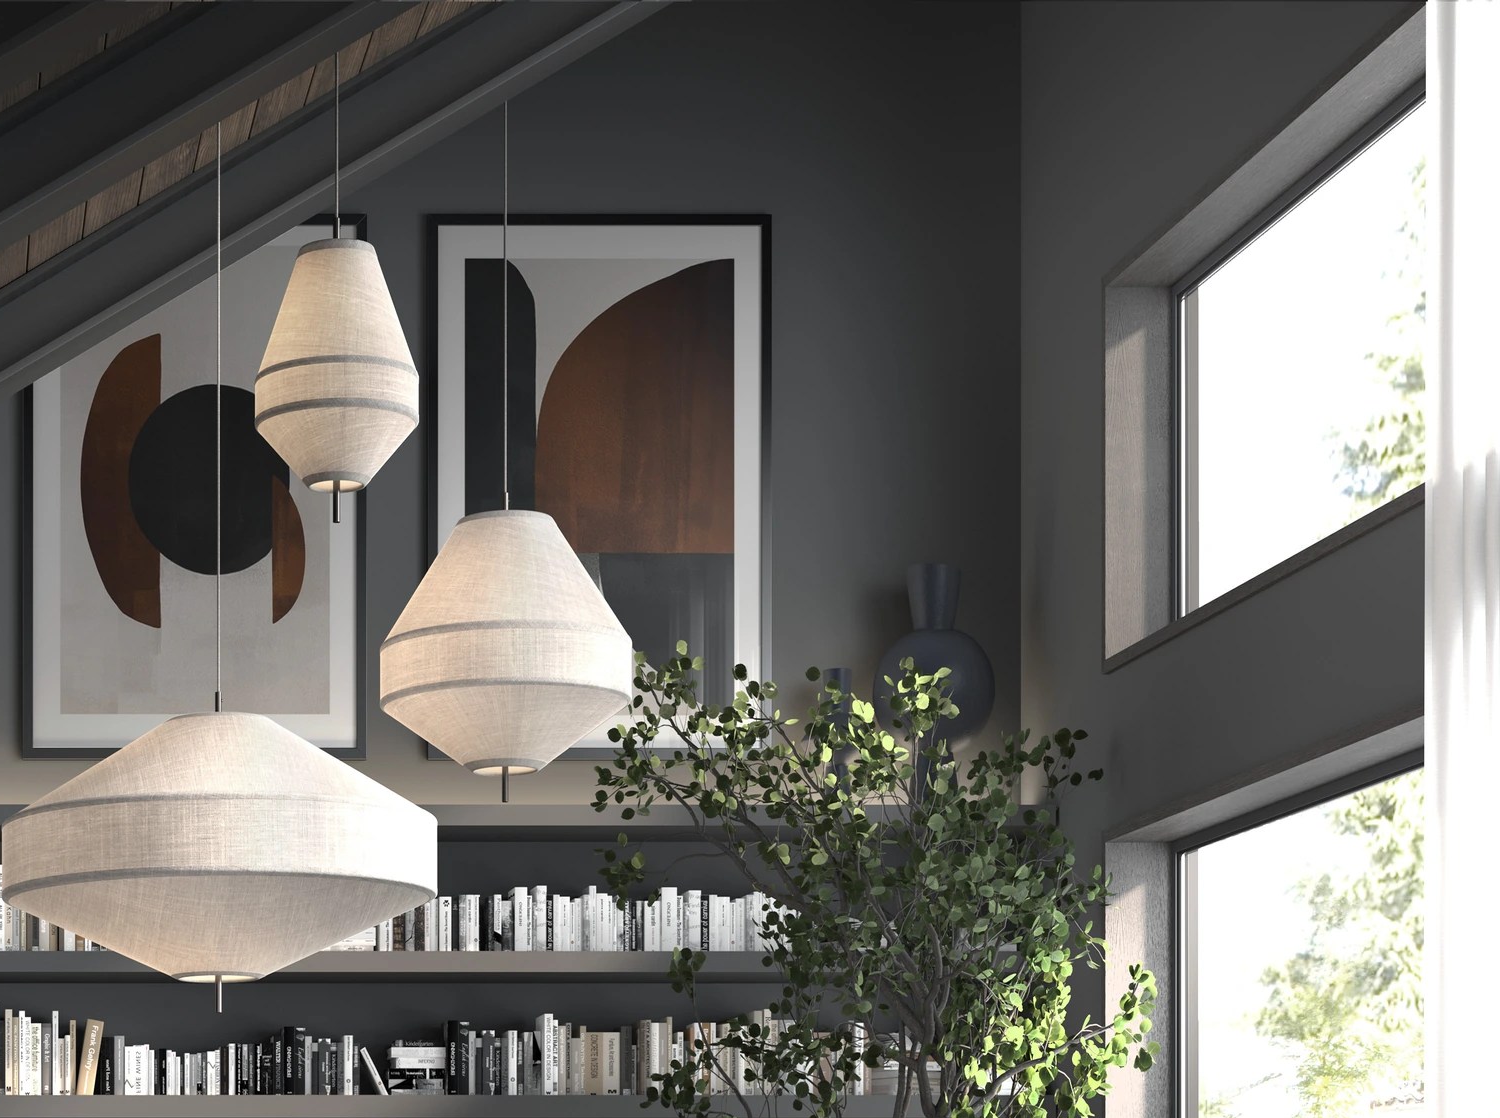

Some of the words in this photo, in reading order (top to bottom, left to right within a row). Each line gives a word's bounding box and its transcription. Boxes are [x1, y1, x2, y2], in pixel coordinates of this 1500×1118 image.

[90, 1025, 99, 1048] Frank
[591, 1034, 599, 1056] CONCRETE
[84, 1048, 96, 1072] Gehry
[591, 1062, 599, 1078] DESIGN
